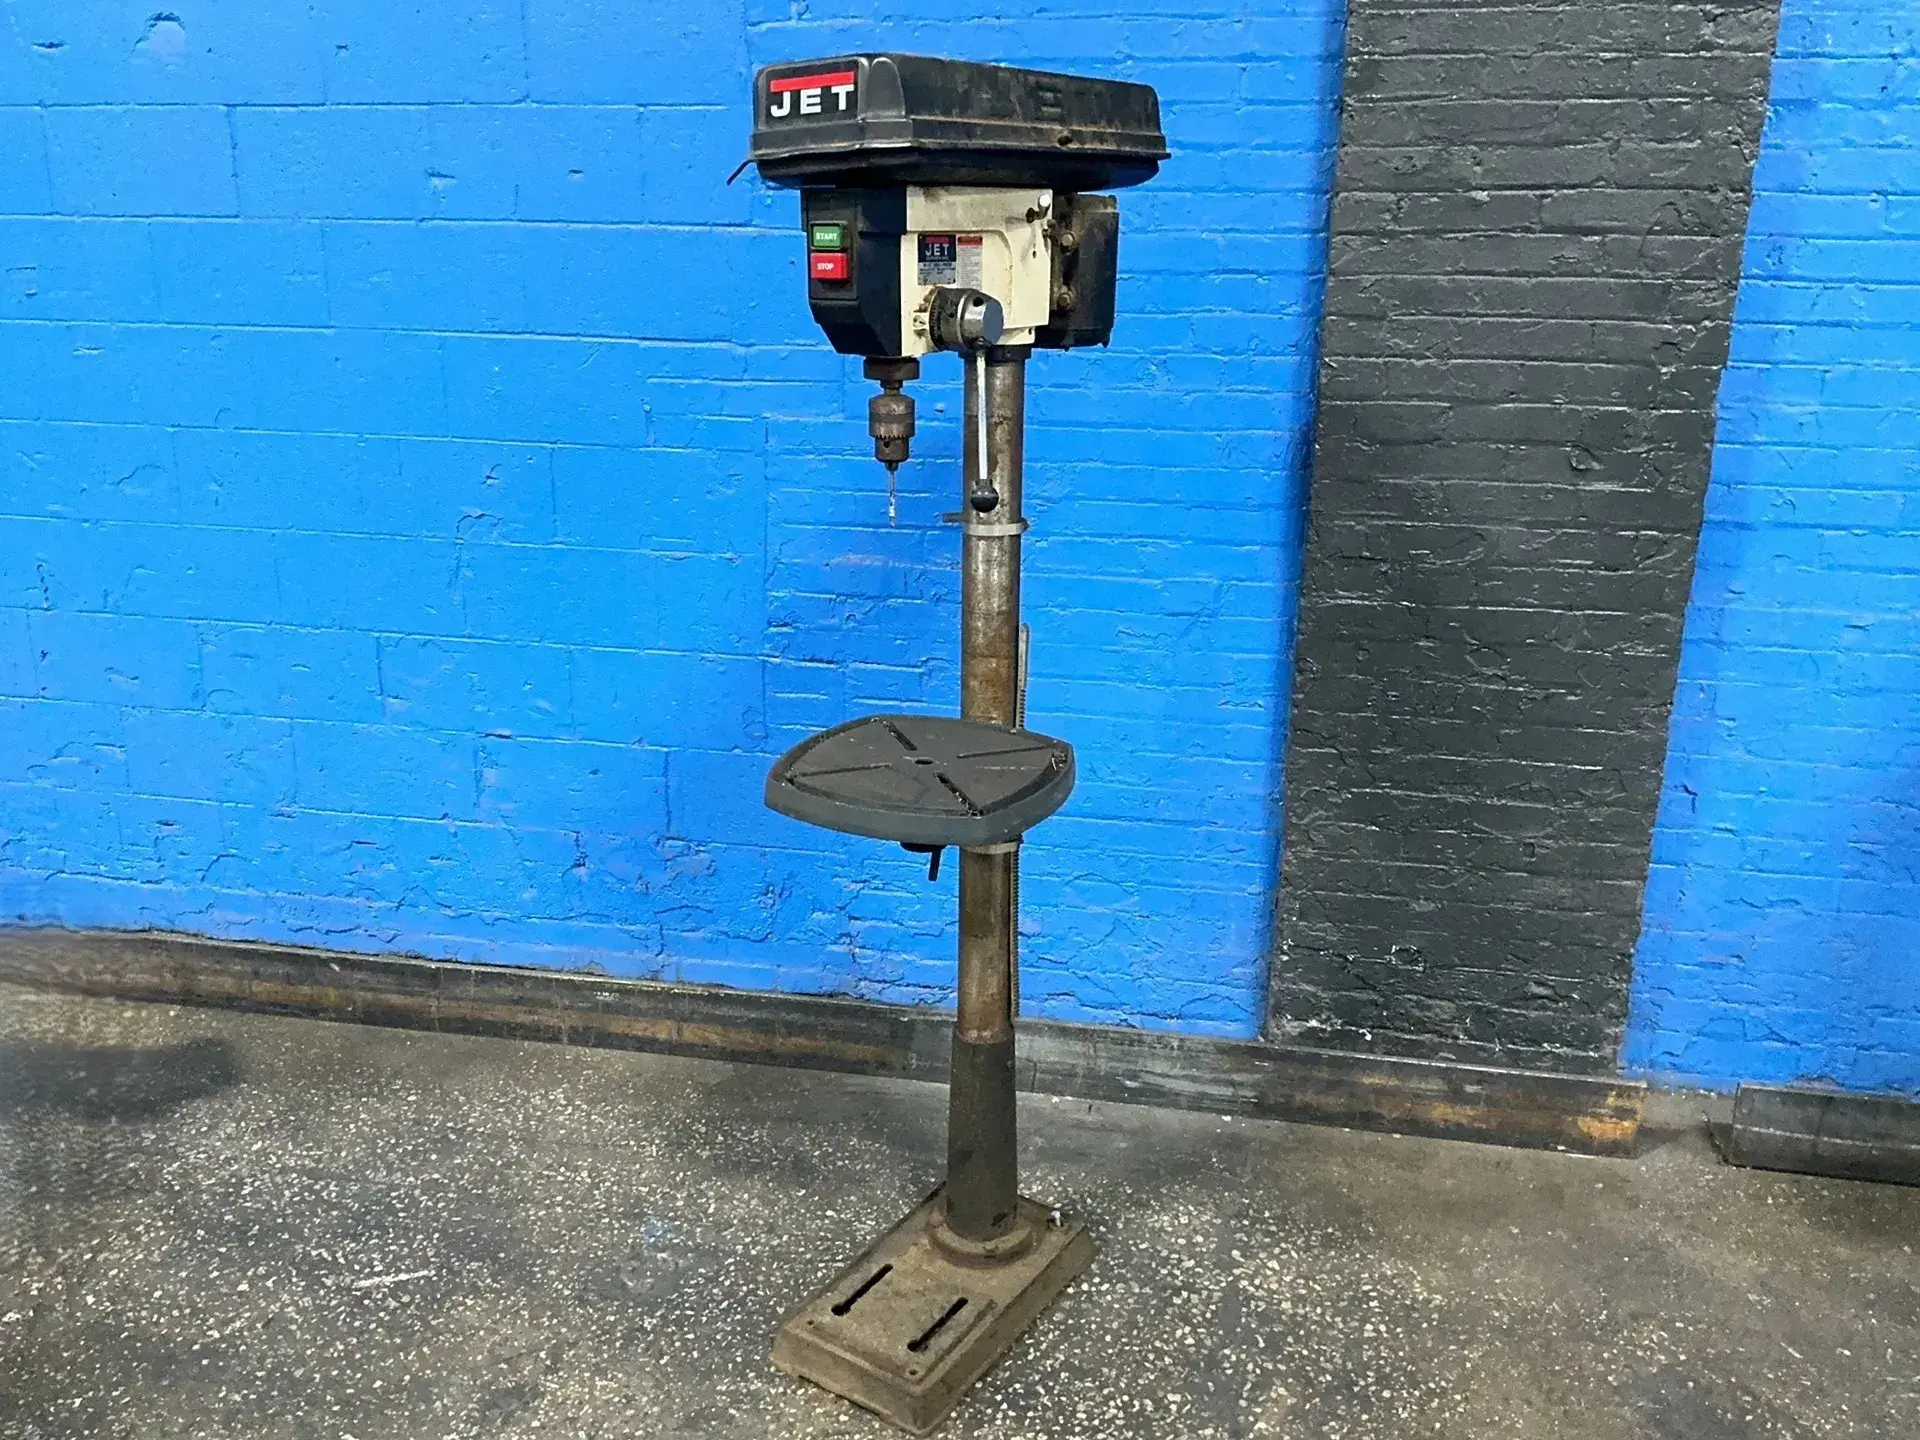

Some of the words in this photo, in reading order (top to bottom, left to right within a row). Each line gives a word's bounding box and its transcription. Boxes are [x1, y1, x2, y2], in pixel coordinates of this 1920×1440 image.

[770, 84, 854, 117] JET
[816, 232, 838, 241] START
[925, 244, 949, 256] JET
[816, 262, 835, 271] STOP
